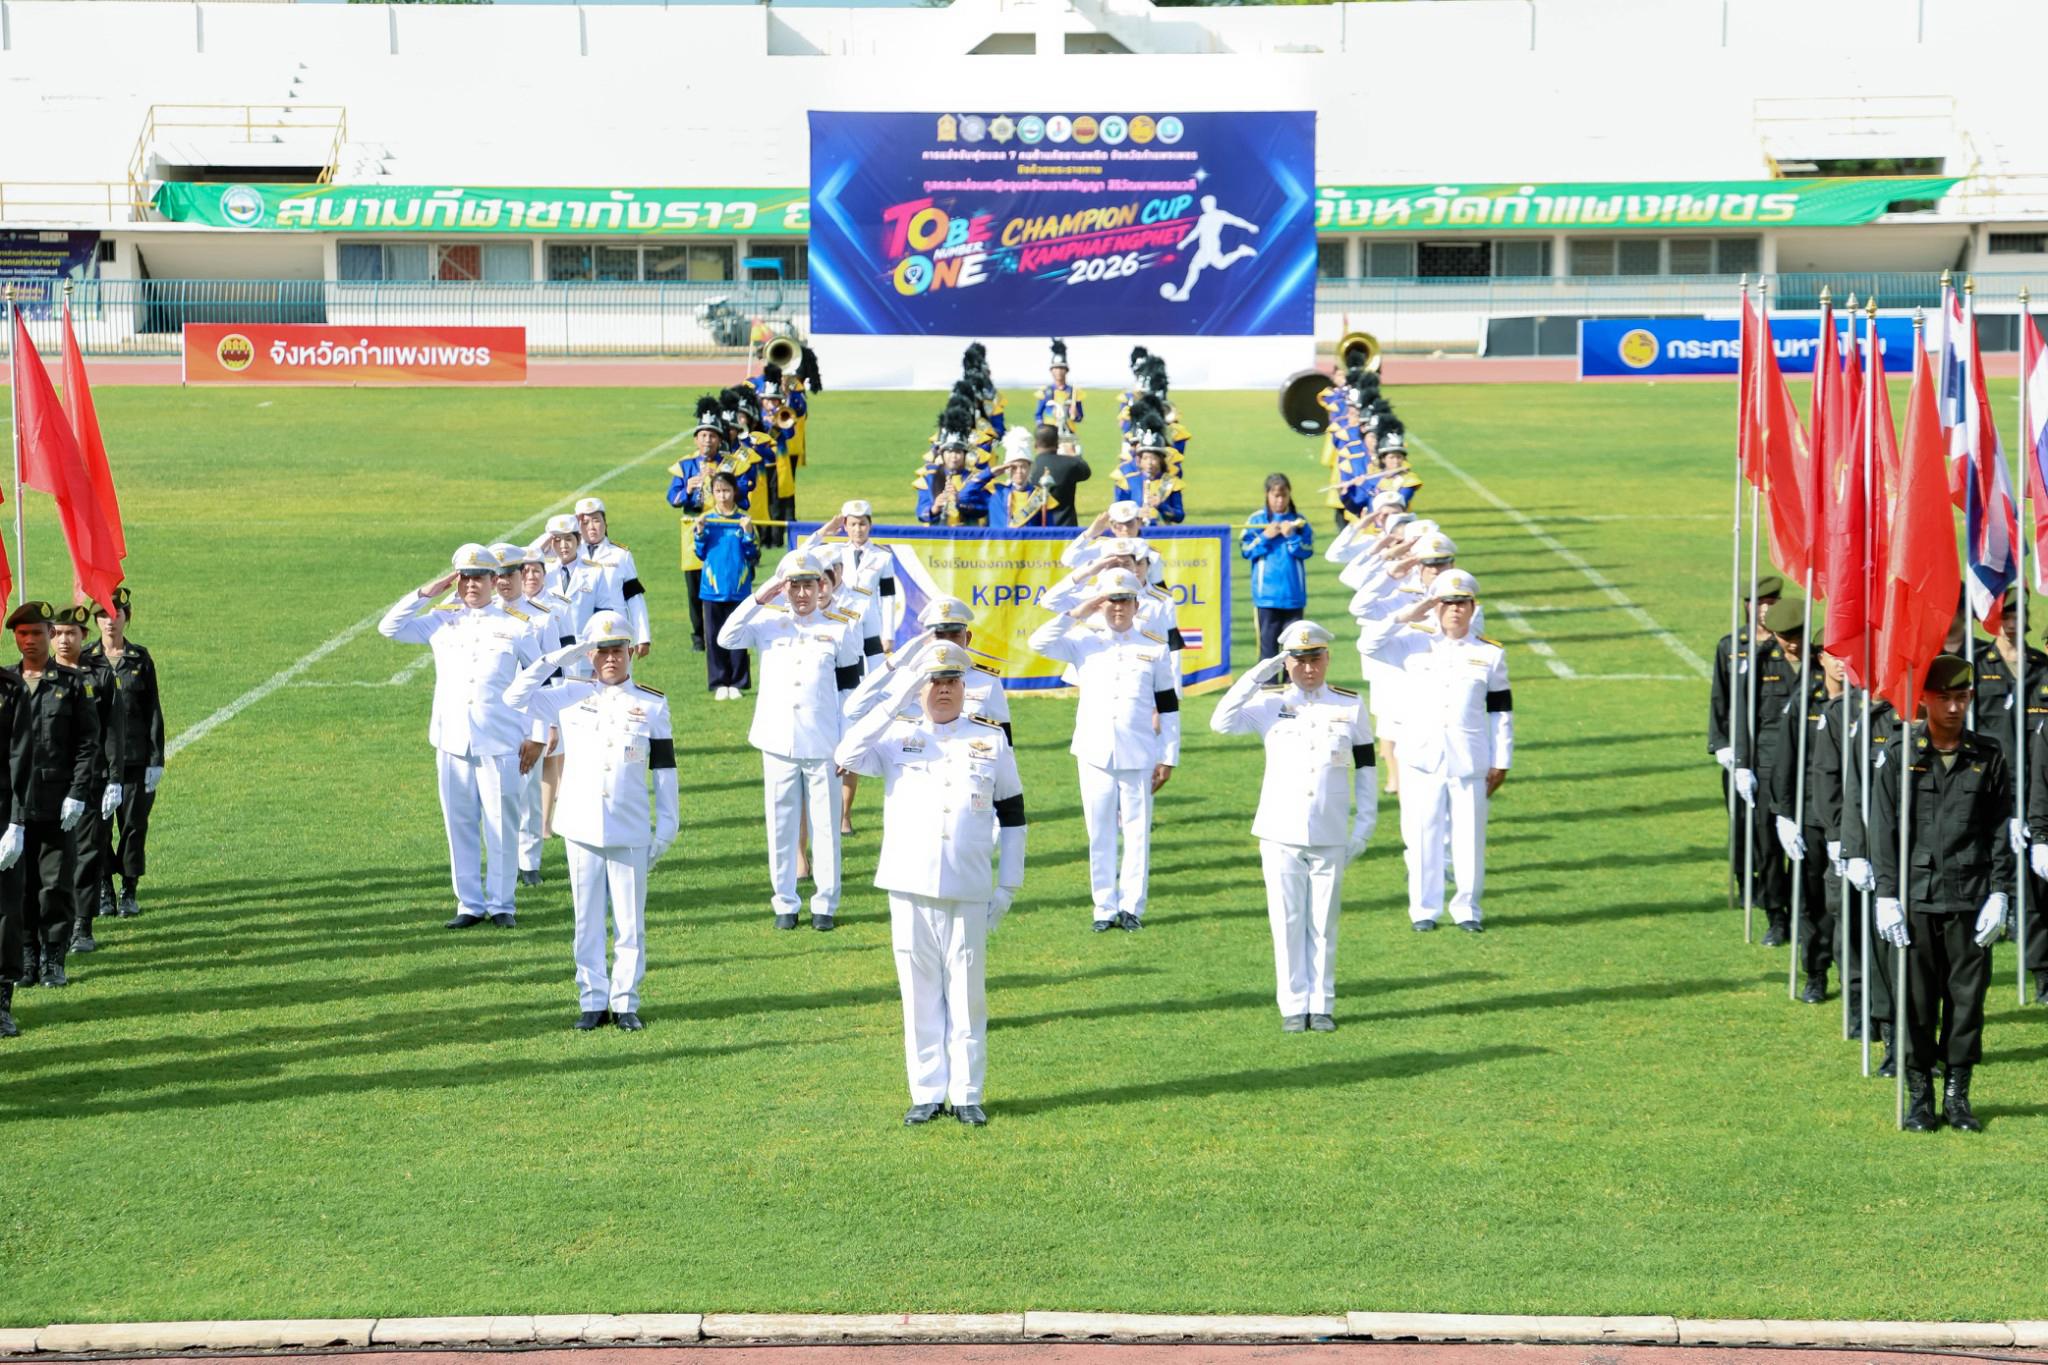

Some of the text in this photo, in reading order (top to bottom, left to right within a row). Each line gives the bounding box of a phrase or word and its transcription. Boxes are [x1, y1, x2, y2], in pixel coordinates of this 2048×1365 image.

[275, 189, 758, 231] สนามกีฬาชากังราว
[883, 197, 993, 257] TO BE
[1001, 194, 1193, 247] CHAMPION CUP
[934, 242, 984, 260] NUMBER
[1066, 252, 1140, 285] 2026
[893, 253, 989, 297] ONE
[269, 338, 491, 366] จังหวัดกำแพงเพชร
